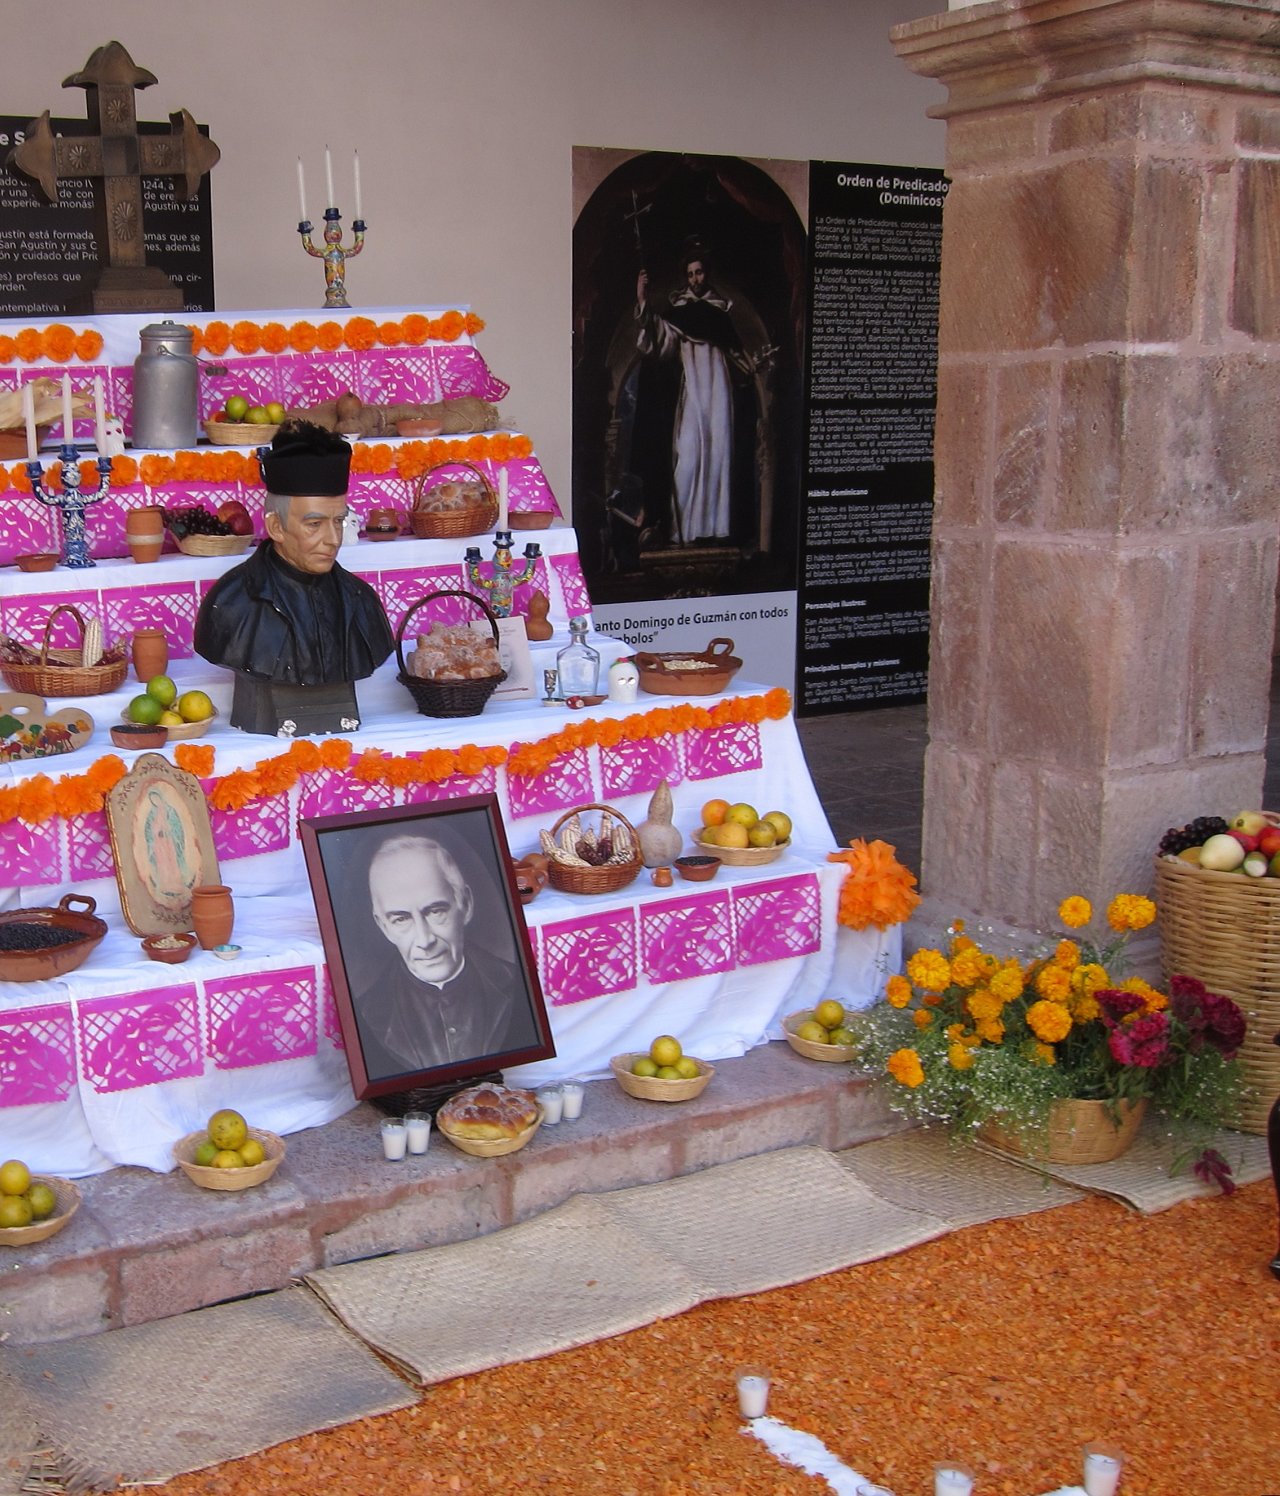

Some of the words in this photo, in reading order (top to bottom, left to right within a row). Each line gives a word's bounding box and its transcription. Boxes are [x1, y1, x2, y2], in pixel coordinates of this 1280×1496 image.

[142, 181, 166, 191] 1244,
[837, 174, 873, 187] Orden
[876, 176, 890, 189] de
[144, 201, 180, 211] Agustín
[29, 231, 50, 239] está
[53, 230, 93, 240] formada
[170, 234, 187, 243] que
[20, 241, 57, 251] Agustín
[165, 243, 200, 252] además
[22, 252, 62, 261] cuidado
[65, 252, 79, 260] del
[17, 273, 58, 282] profesos
[63, 274, 81, 282] que
[805, 602, 840, 610] Personajes
[624, 616, 674, 631] Domingo
[678, 614, 691, 625] de
[694, 610, 737, 624] Guzmán
[740, 610, 757, 620] con
[760, 607, 788, 619] todos
[805, 664, 840, 673] Principales
[841, 661, 866, 670] templos
[873, 659, 900, 667] misiones
